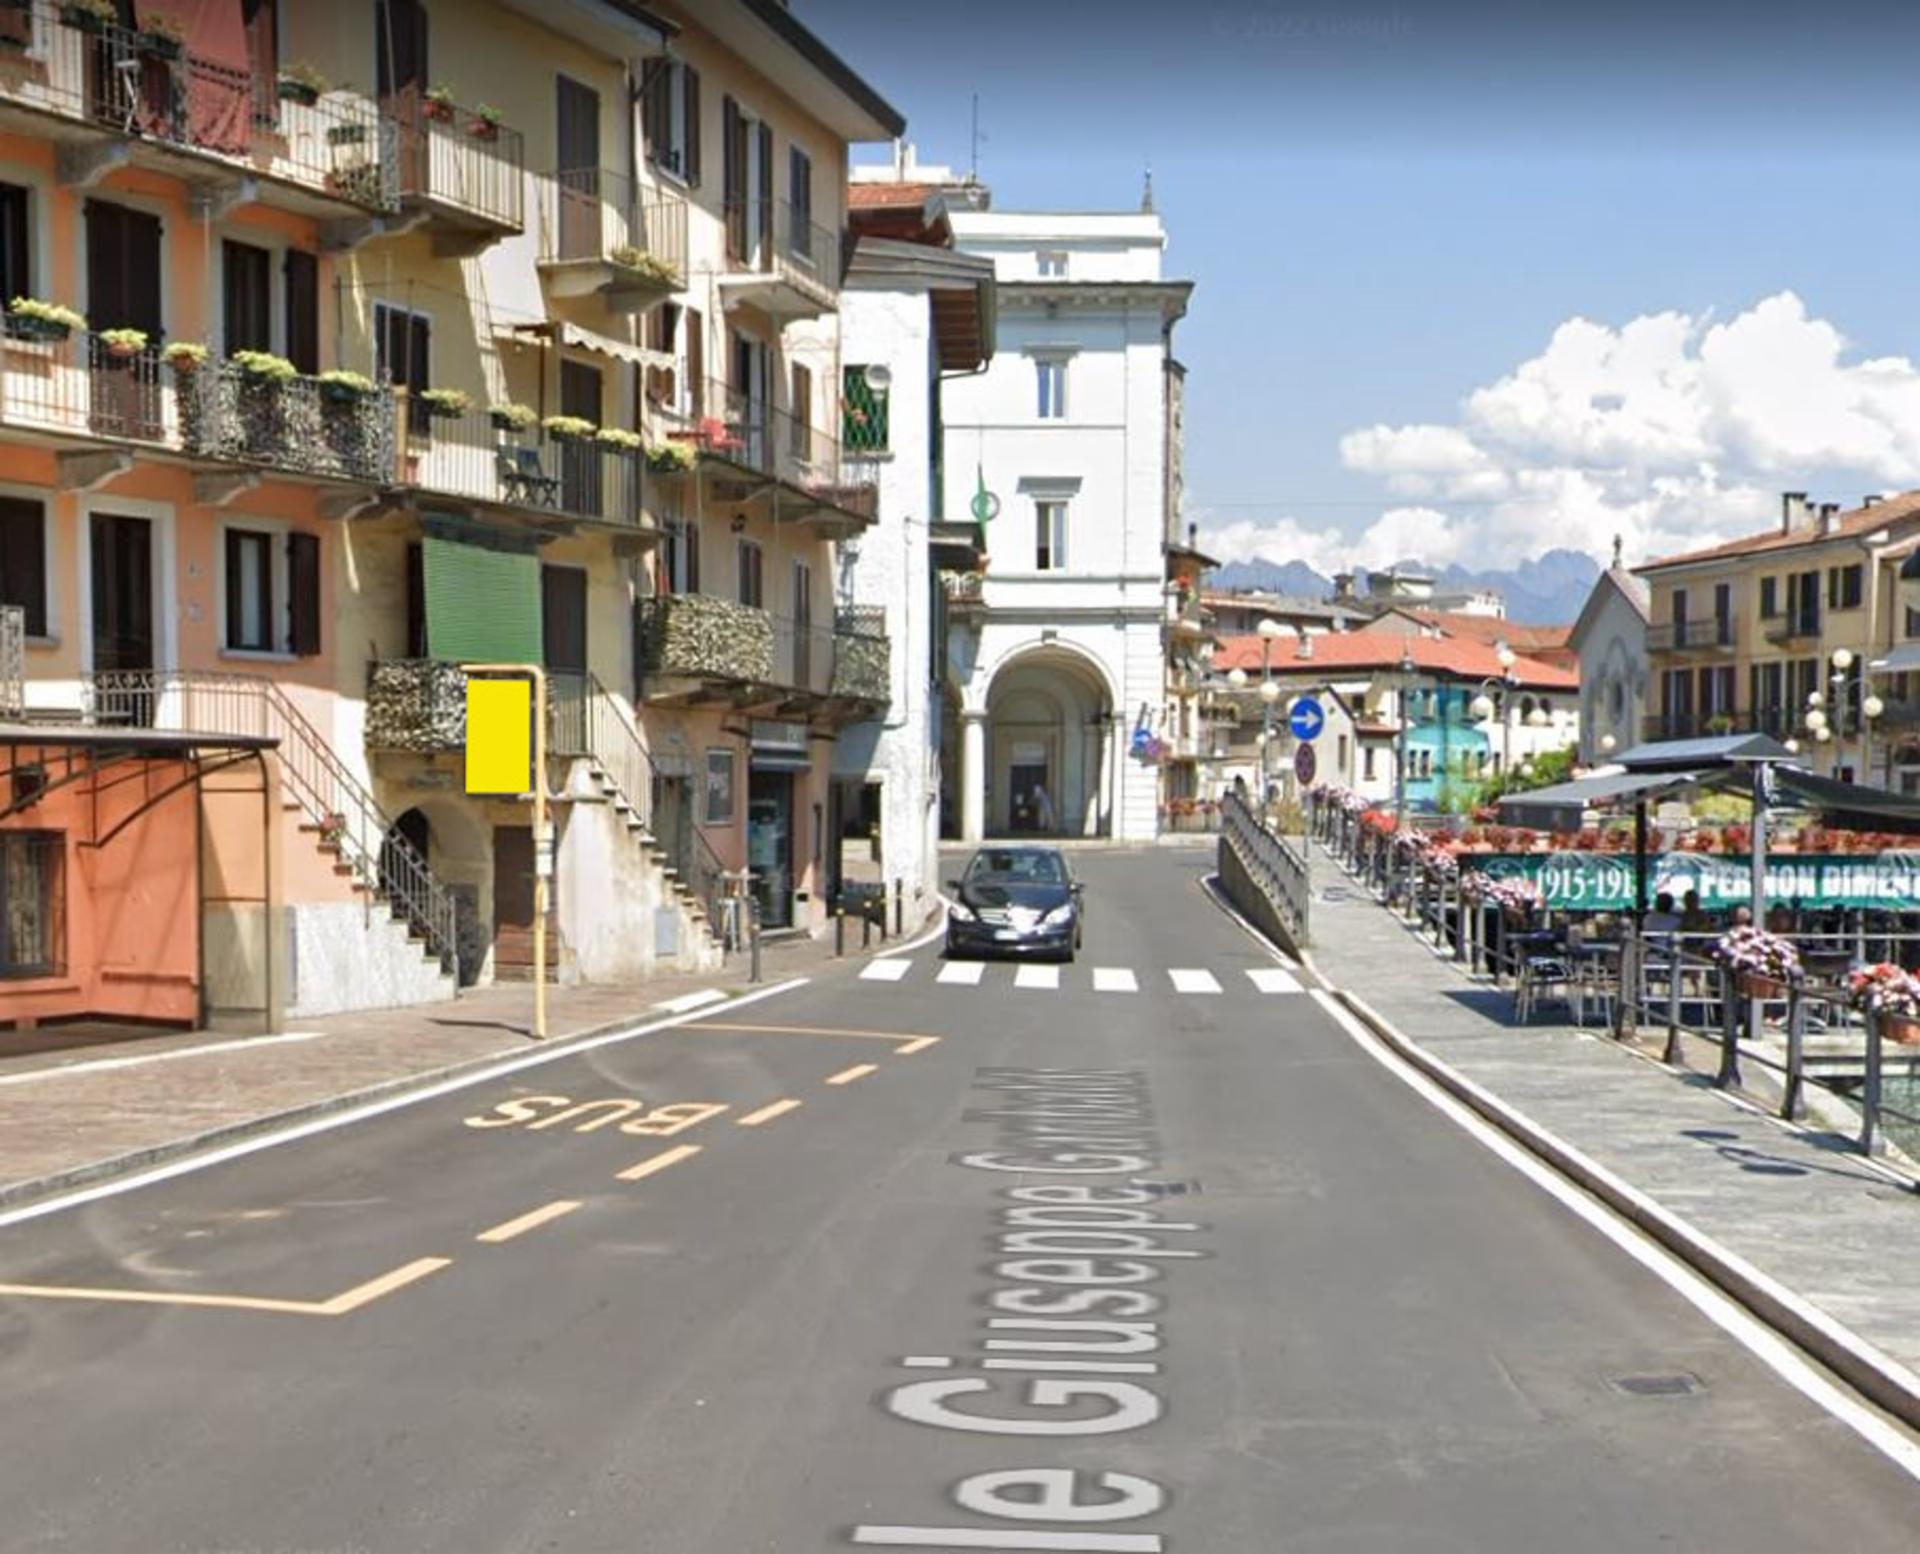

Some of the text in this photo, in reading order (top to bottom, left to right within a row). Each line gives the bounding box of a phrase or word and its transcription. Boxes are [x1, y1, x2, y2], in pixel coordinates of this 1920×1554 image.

[1536, 868, 1637, 900] 1915-191
[1699, 864, 1752, 899] PER
[1763, 864, 1817, 898] NON
[463, 1095, 730, 1136] BUS
